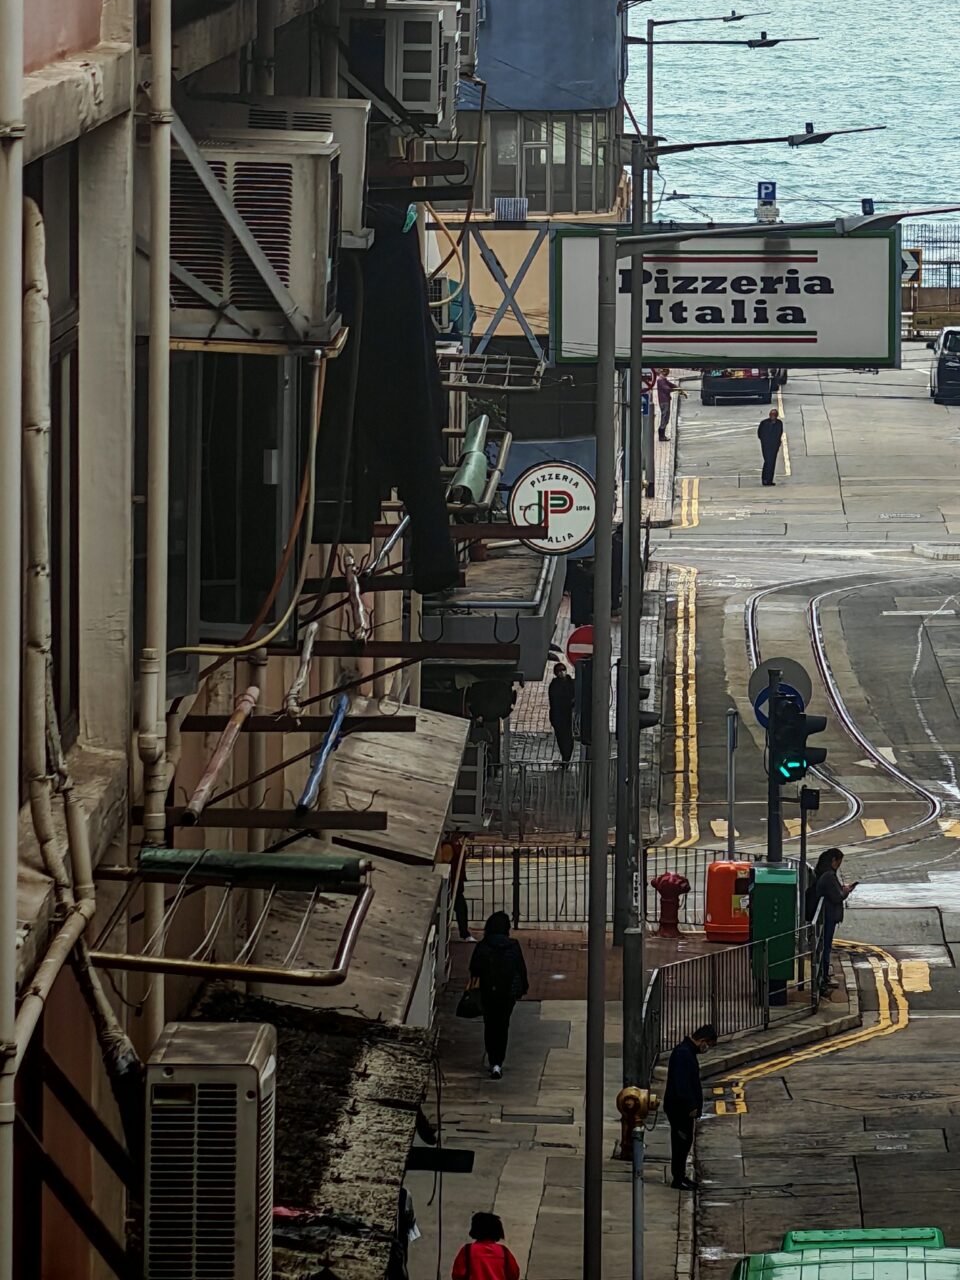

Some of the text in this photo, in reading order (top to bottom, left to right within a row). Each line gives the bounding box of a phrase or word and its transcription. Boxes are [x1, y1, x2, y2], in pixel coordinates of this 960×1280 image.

[760, 183, 773, 199] P
[618, 268, 834, 295] Pizzeria
[645, 298, 807, 324] Italia
[530, 473, 580, 489] PIZZERIA
[541, 532, 574, 544] ALIA
